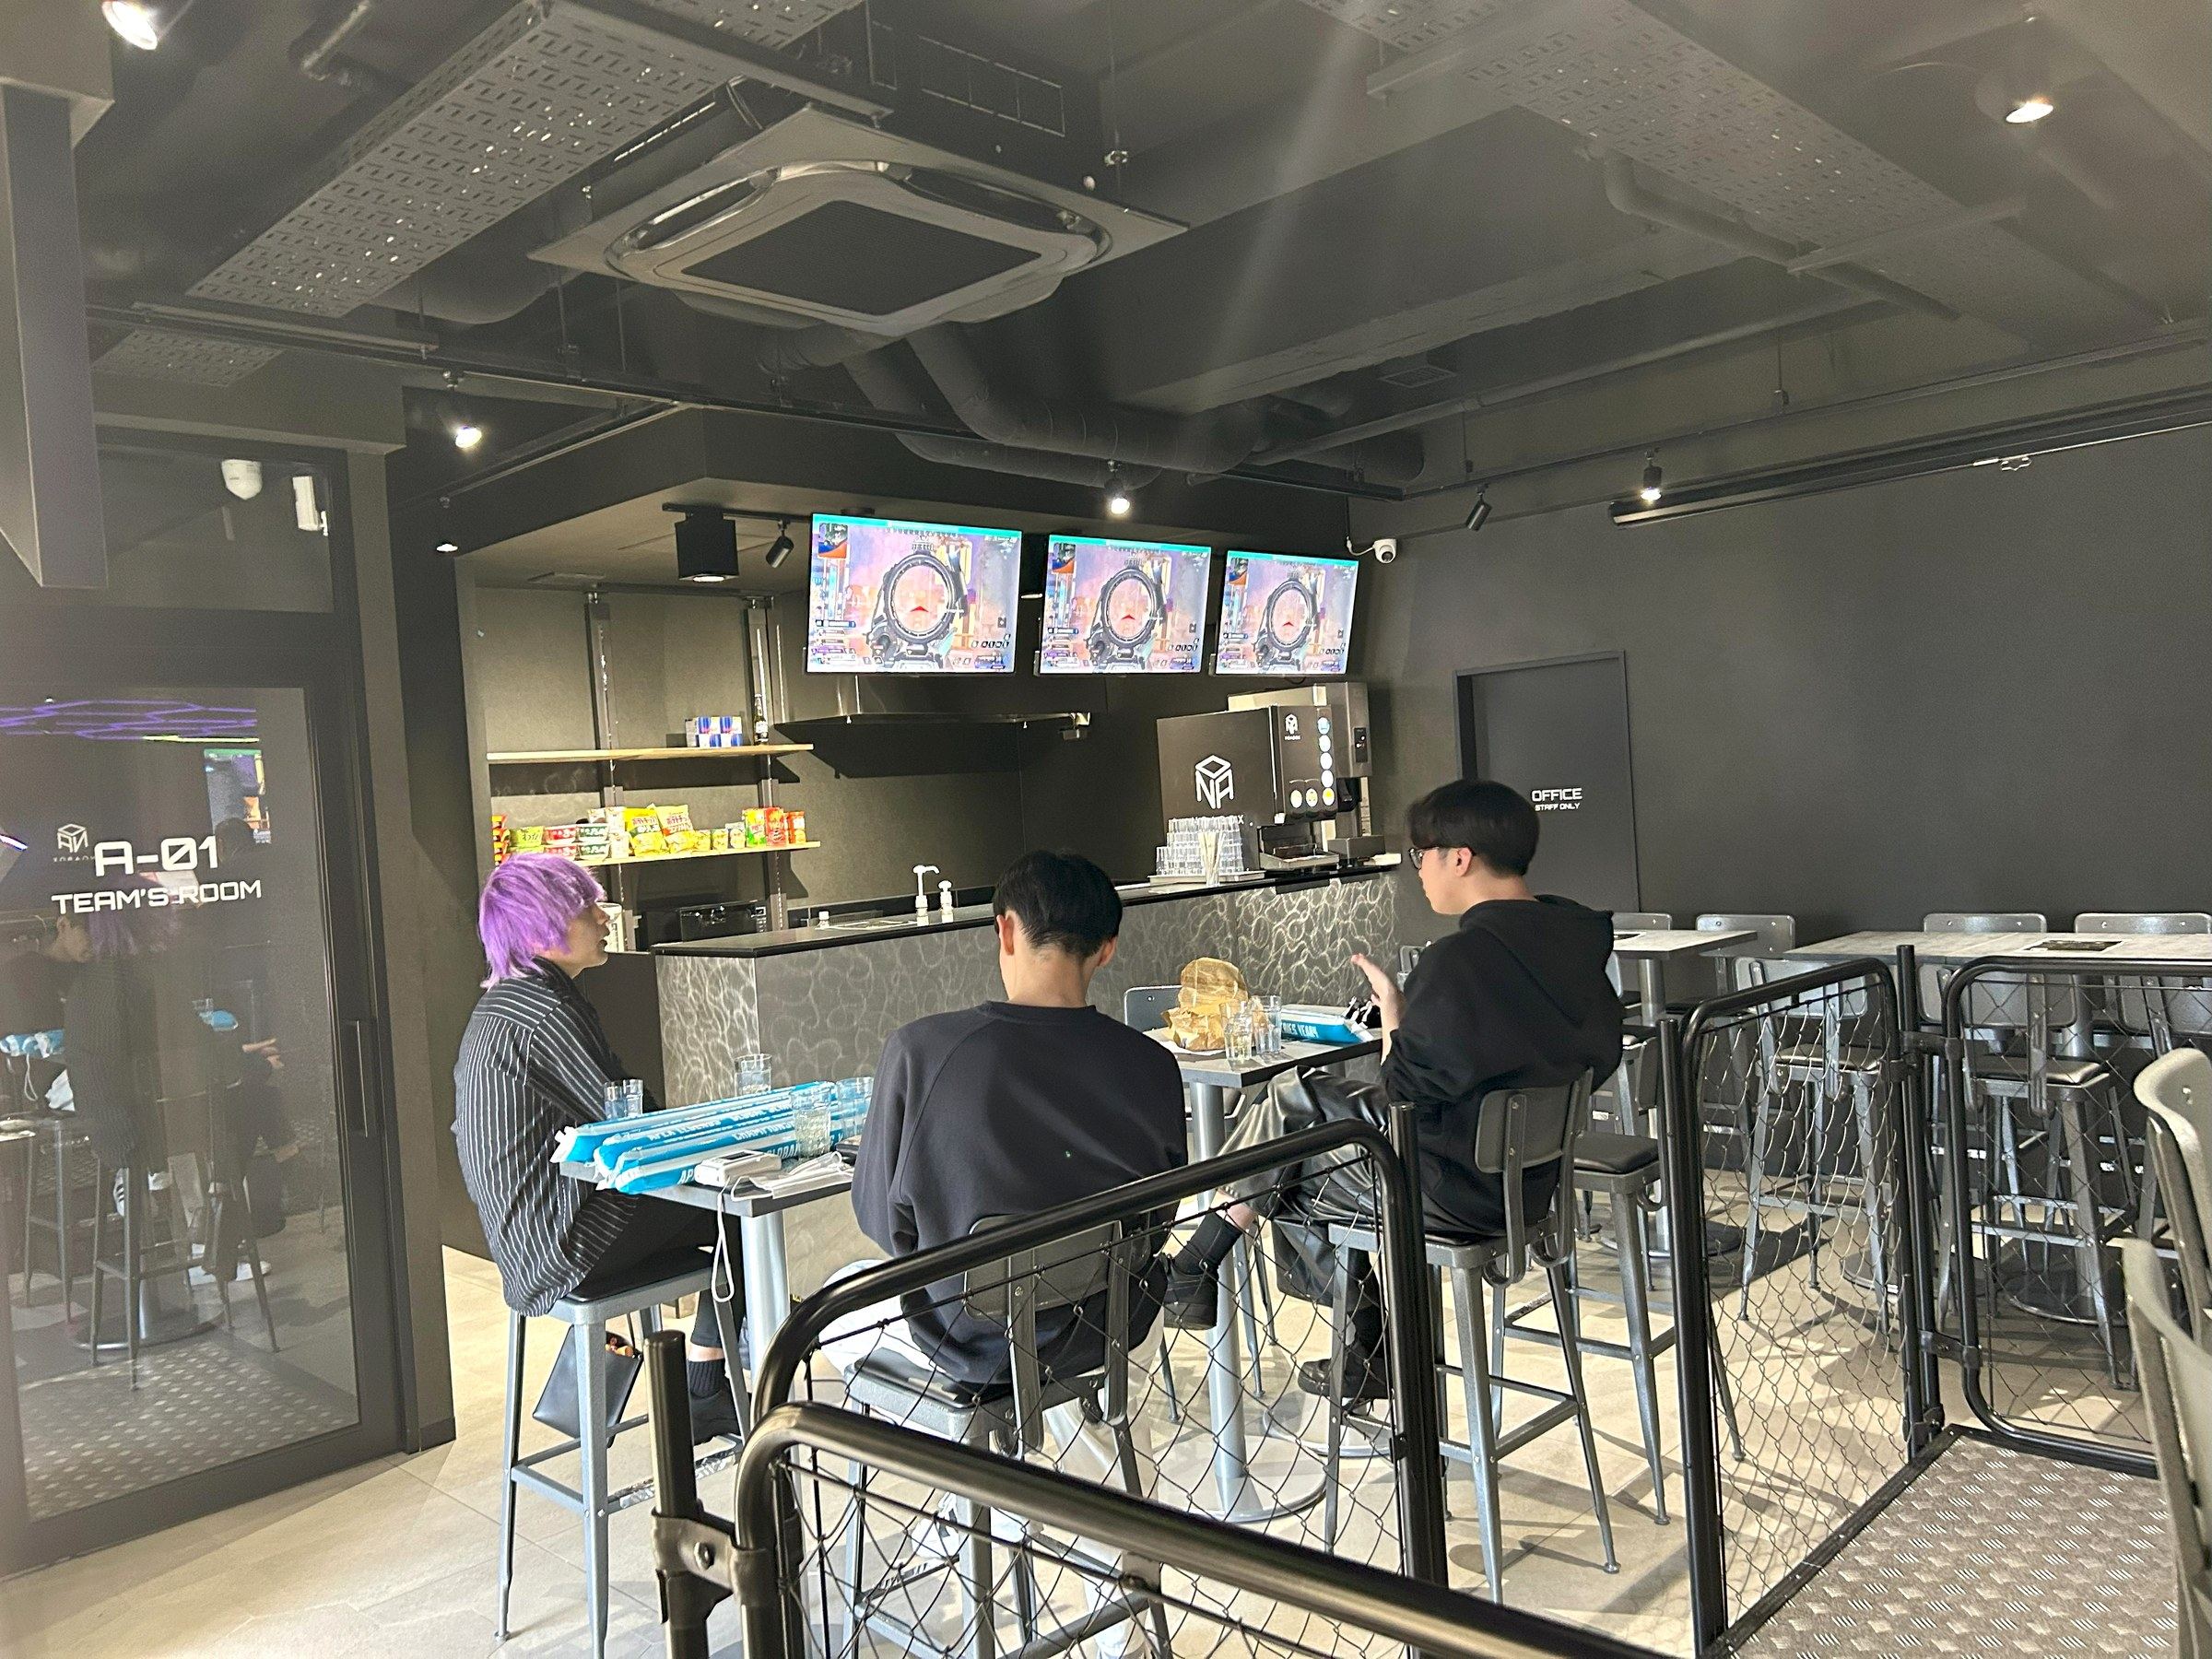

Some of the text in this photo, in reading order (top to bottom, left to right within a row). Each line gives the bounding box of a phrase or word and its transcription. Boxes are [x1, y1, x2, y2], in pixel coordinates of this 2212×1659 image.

[1531, 788, 1583, 802] OFFICE
[1535, 803, 1559, 811] STAFF
[94, 835, 218, 877] A-01
[51, 879, 262, 915] TEAM'S ROOM
[677, 1168, 695, 1185] AP
